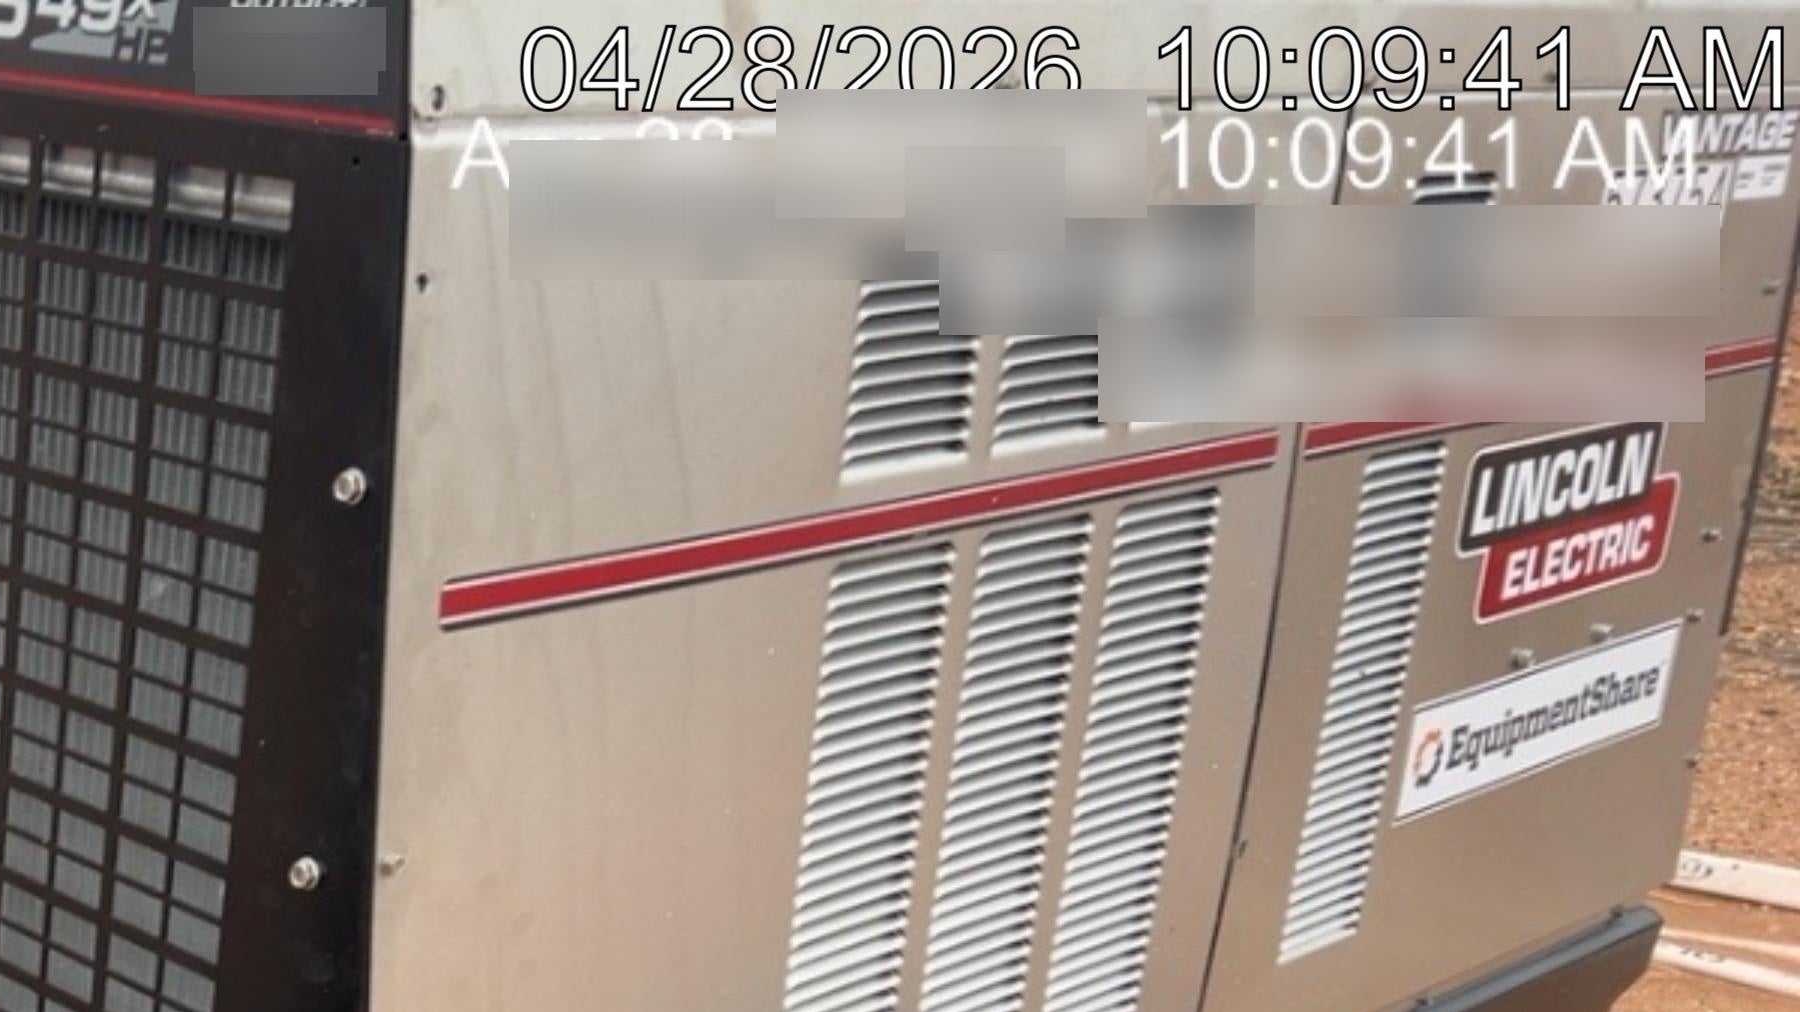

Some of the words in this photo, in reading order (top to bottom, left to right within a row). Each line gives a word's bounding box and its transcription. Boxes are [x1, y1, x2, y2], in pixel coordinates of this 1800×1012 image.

[1470, 430, 1655, 538] LINCOLN
[1500, 515, 1655, 601] ELECTRIC
[1445, 663, 1661, 771] EquipmentShare
